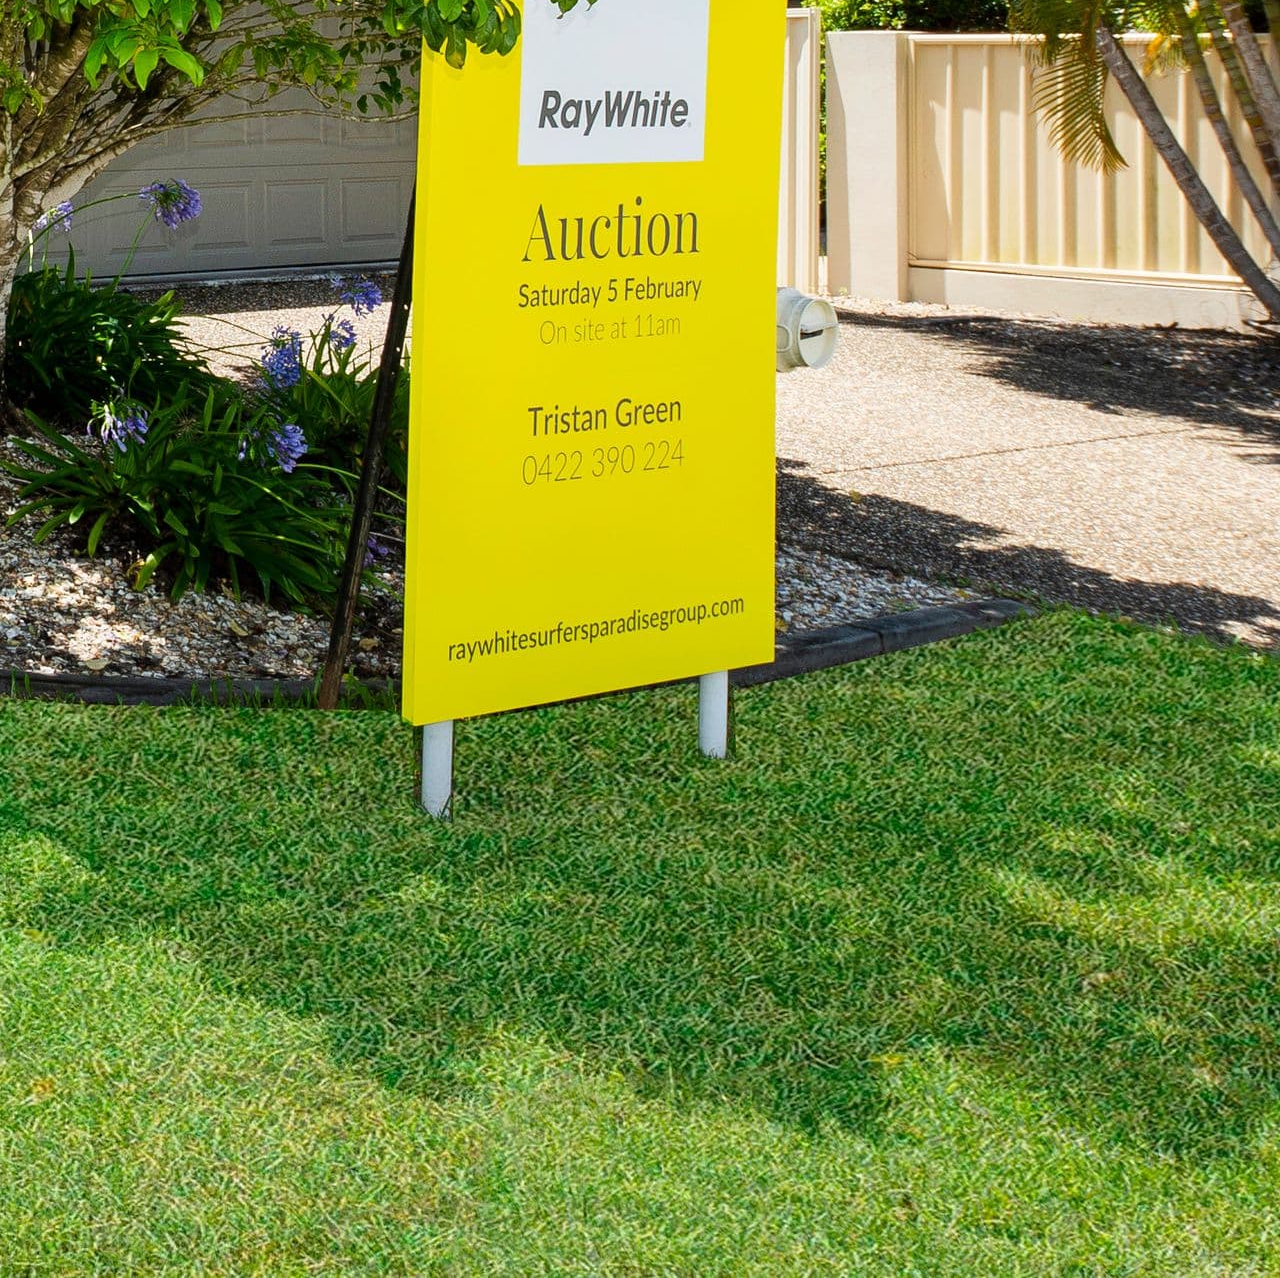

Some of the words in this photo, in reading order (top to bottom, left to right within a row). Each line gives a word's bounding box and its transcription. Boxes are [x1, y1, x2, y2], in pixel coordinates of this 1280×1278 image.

[521, 195, 701, 264] Auction
[518, 280, 602, 309] Saturday
[607, 278, 619, 304] 5
[624, 276, 703, 304] February
[539, 319, 568, 346] On
[574, 316, 605, 343] site
[611, 317, 627, 340] at
[633, 313, 682, 338] 11am
[528, 405, 608, 438] Tristan
[615, 397, 682, 427] Green
[522, 449, 583, 486] 0422
[590, 445, 636, 478] 390
[643, 438, 686, 473] 224
[447, 595, 745, 662] raywhitesurfersparadisegroup.com
